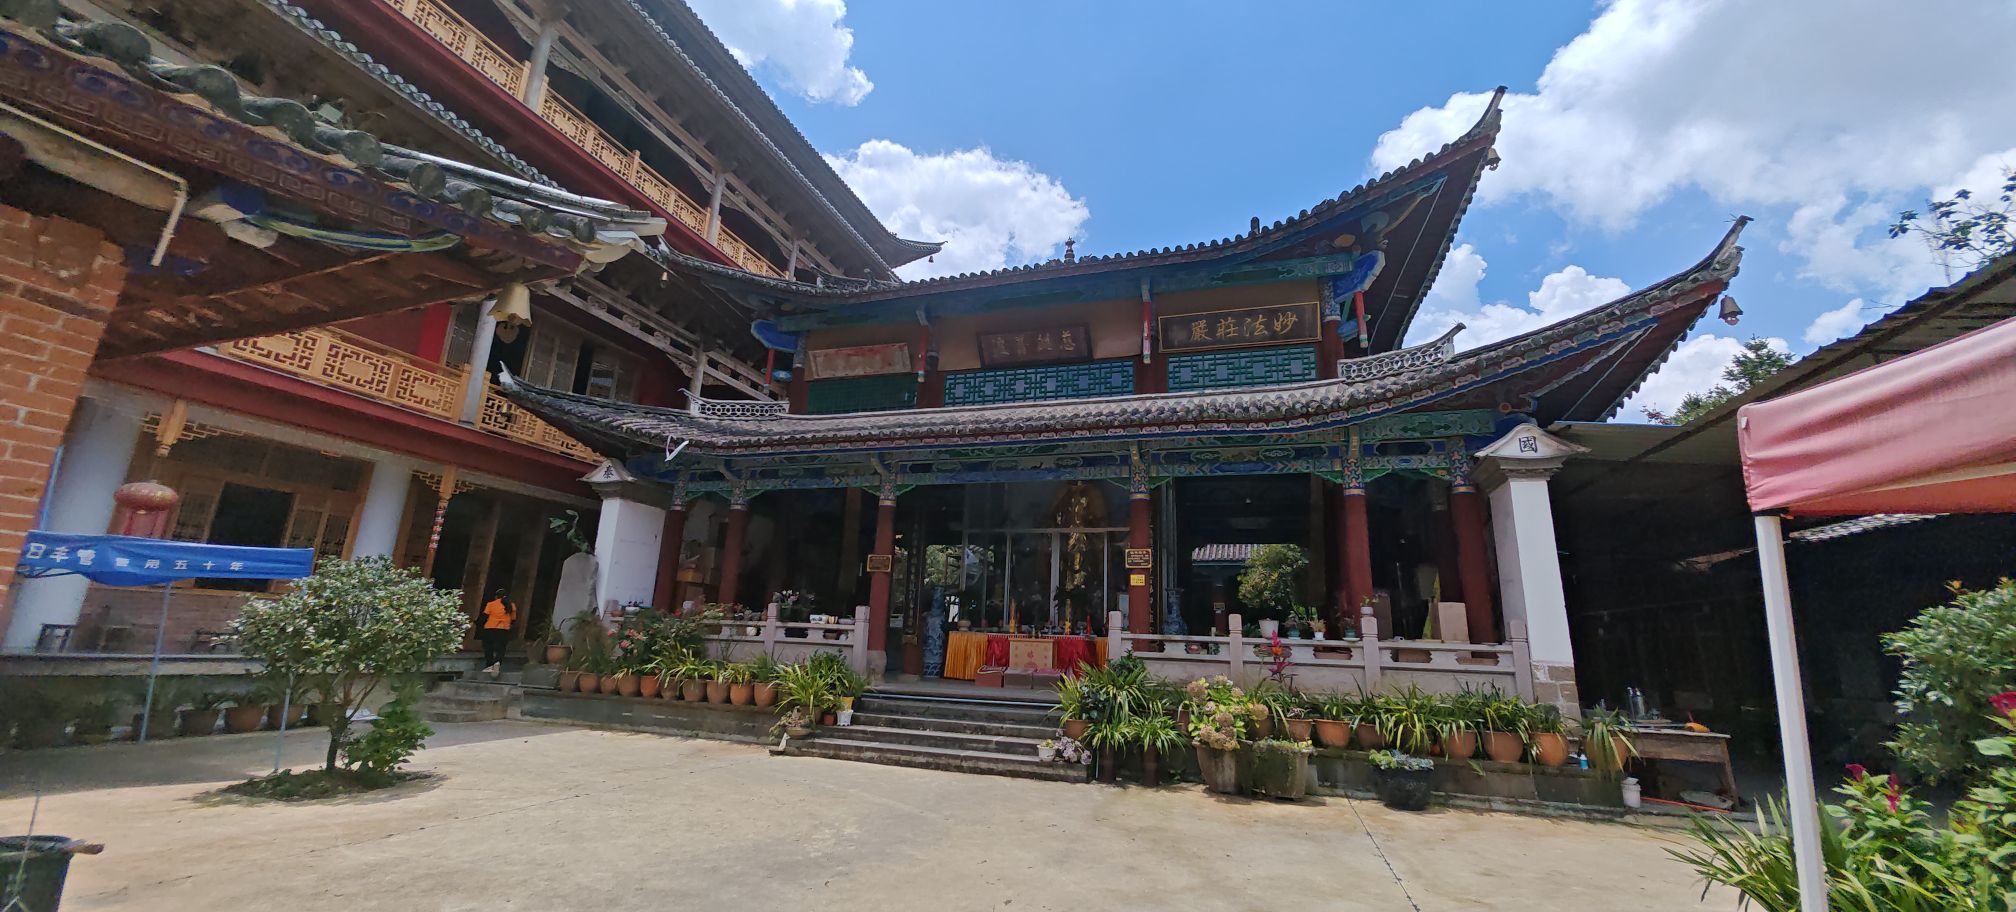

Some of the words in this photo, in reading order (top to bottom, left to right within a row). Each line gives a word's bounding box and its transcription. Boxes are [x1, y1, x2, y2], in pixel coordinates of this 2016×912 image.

[1519, 436, 1538, 453] 國
[26, 542, 96, 566] 日丰管
